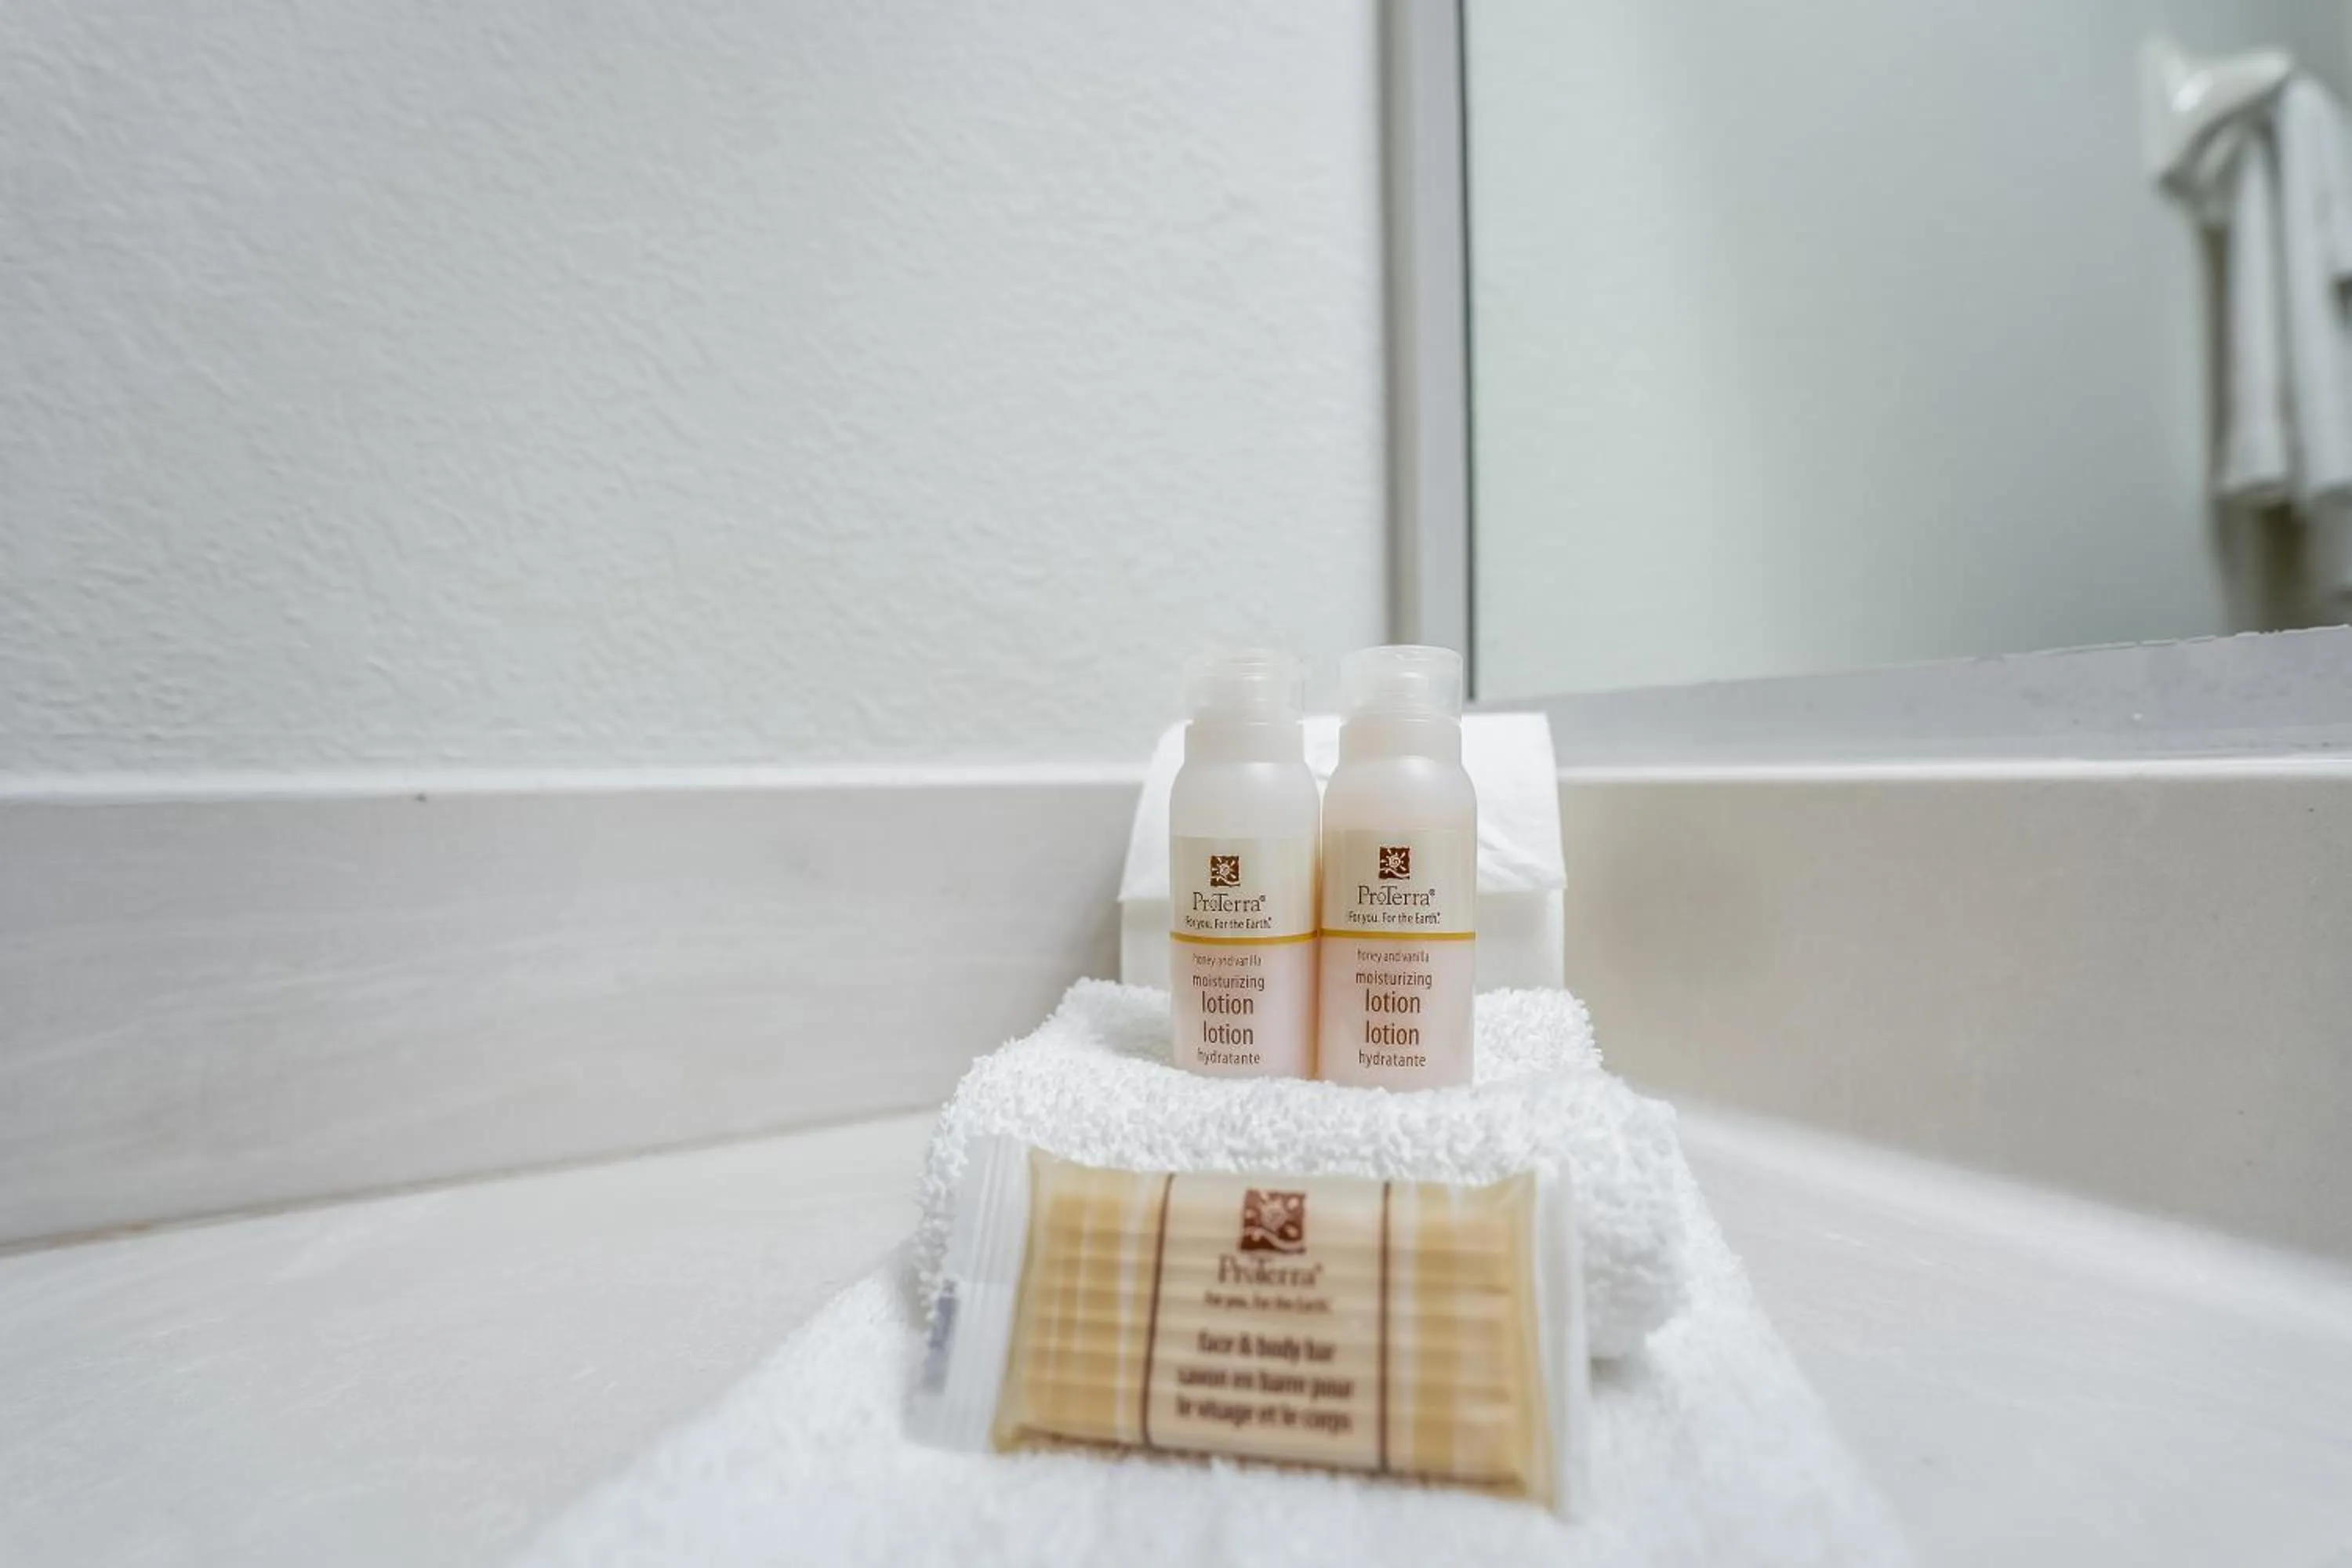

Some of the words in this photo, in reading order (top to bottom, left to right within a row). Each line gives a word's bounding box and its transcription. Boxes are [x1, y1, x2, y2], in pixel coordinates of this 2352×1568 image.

[1214, 918, 1229, 928] For
[1229, 918, 1244, 928] the
[1348, 910, 1360, 923] For
[1382, 912, 1396, 923] For
[1398, 912, 1413, 923] the
[1383, 950, 1400, 962] and
[1192, 973, 1265, 991] moisturizing
[1356, 972, 1433, 989] moisturizing
[1201, 990, 1254, 1014] lotion
[1365, 989, 1421, 1014] lotion
[1203, 1021, 1254, 1045] lotion
[1365, 1020, 1420, 1045] lotion
[1197, 1047, 1261, 1065] hydratante
[1358, 1050, 1427, 1068] hydratante
[1198, 1327, 1232, 1355] face
[1239, 1332, 1252, 1356] &
[1256, 1334, 1301, 1364] body
[1305, 1338, 1337, 1363] bar
[1178, 1367, 1226, 1387] savon
[1232, 1371, 1253, 1389] en
[1258, 1369, 1305, 1394] barre
[1312, 1377, 1356, 1402] pour
[1176, 1393, 1191, 1417] le
[1198, 1398, 1253, 1429] visage
[1259, 1403, 1276, 1424] et
[1281, 1403, 1298, 1426] le
